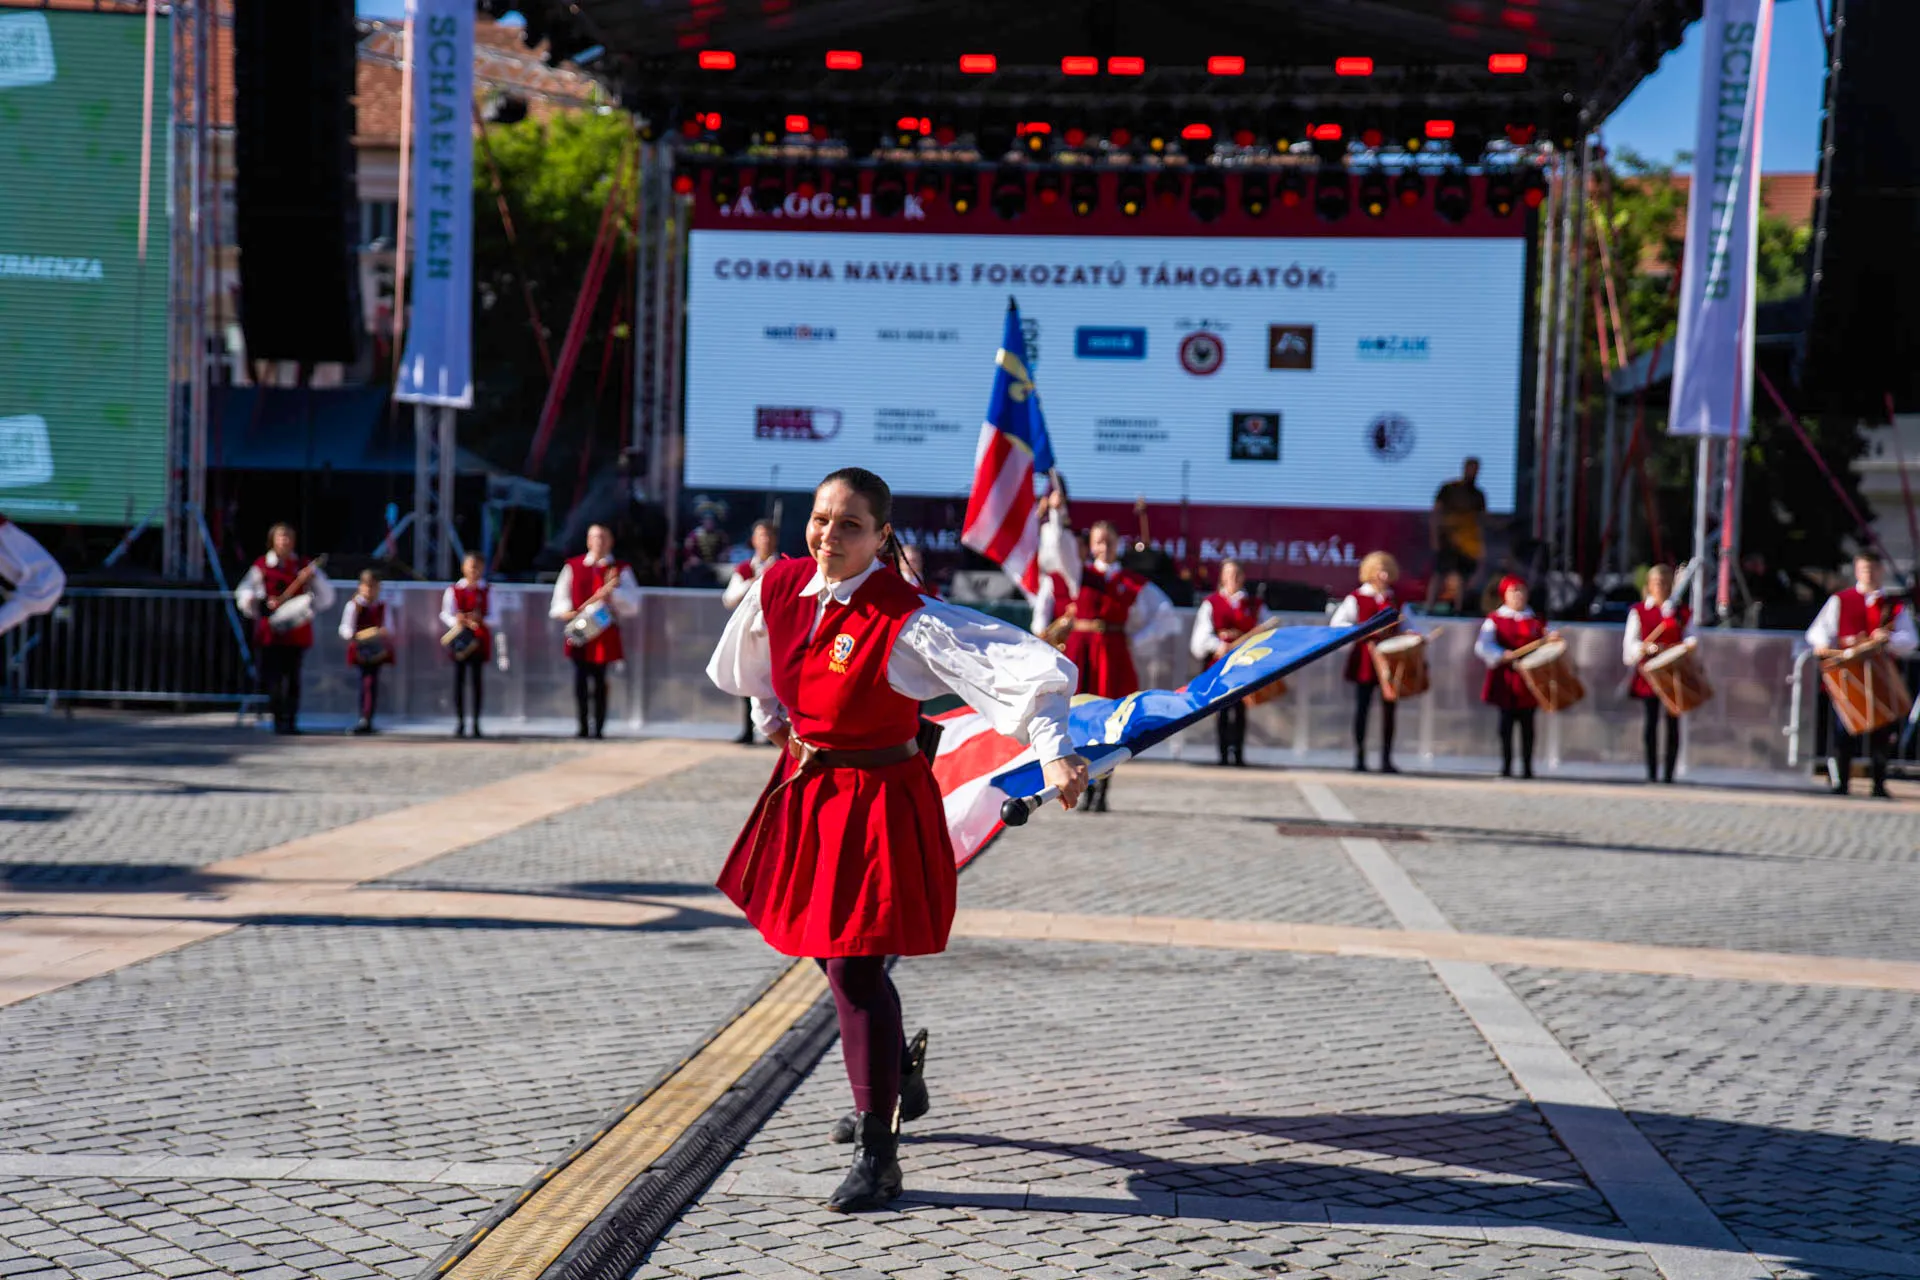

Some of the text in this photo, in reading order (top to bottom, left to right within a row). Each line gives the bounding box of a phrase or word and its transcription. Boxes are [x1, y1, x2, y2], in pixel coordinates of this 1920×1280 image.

[428, 14, 457, 280] SCHAEFFLER
[714, 257, 834, 281] CORONA
[844, 260, 961, 284] NAVALIS
